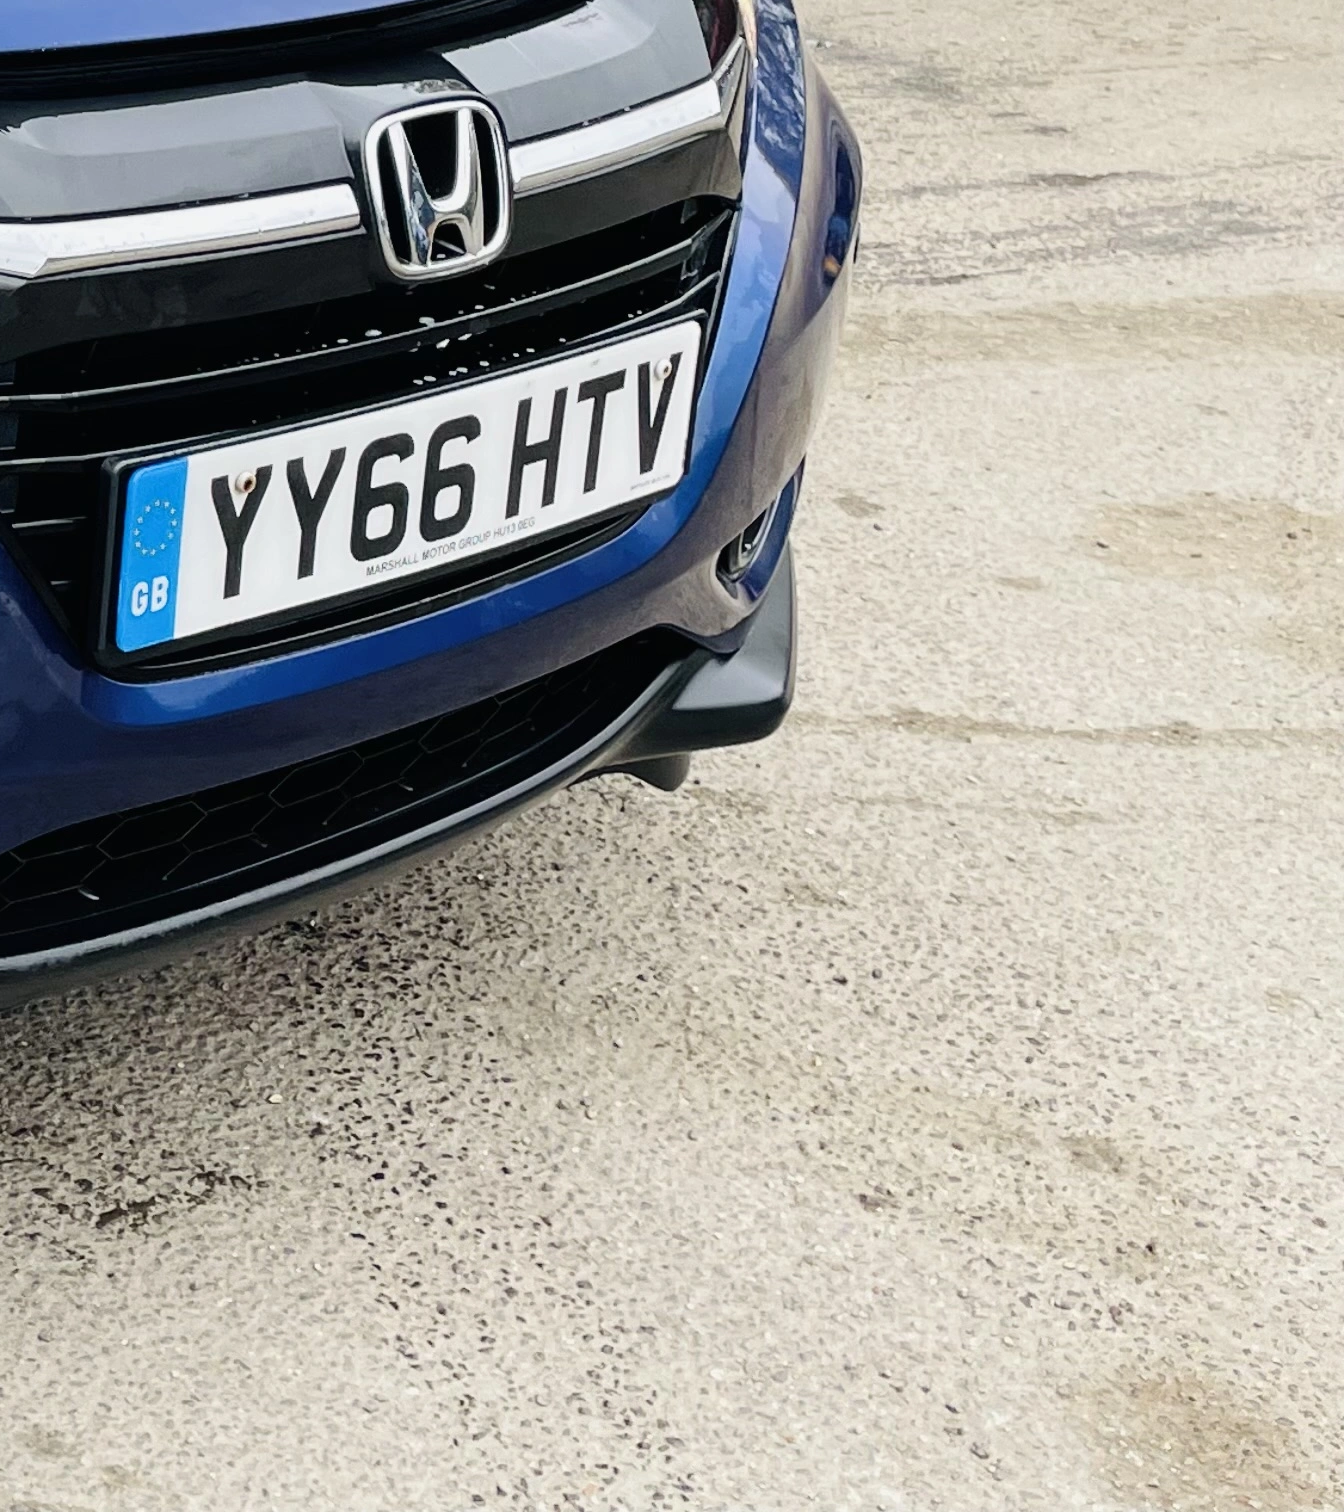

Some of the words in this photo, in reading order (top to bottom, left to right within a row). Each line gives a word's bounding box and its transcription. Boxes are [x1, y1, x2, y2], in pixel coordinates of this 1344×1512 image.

[212, 413, 481, 599] YY66
[504, 351, 684, 520] HTV
[365, 552, 419, 576] MARSHALL
[421, 541, 457, 561] MOTOR
[458, 530, 492, 550] GROUP
[130, 574, 169, 617] GB
